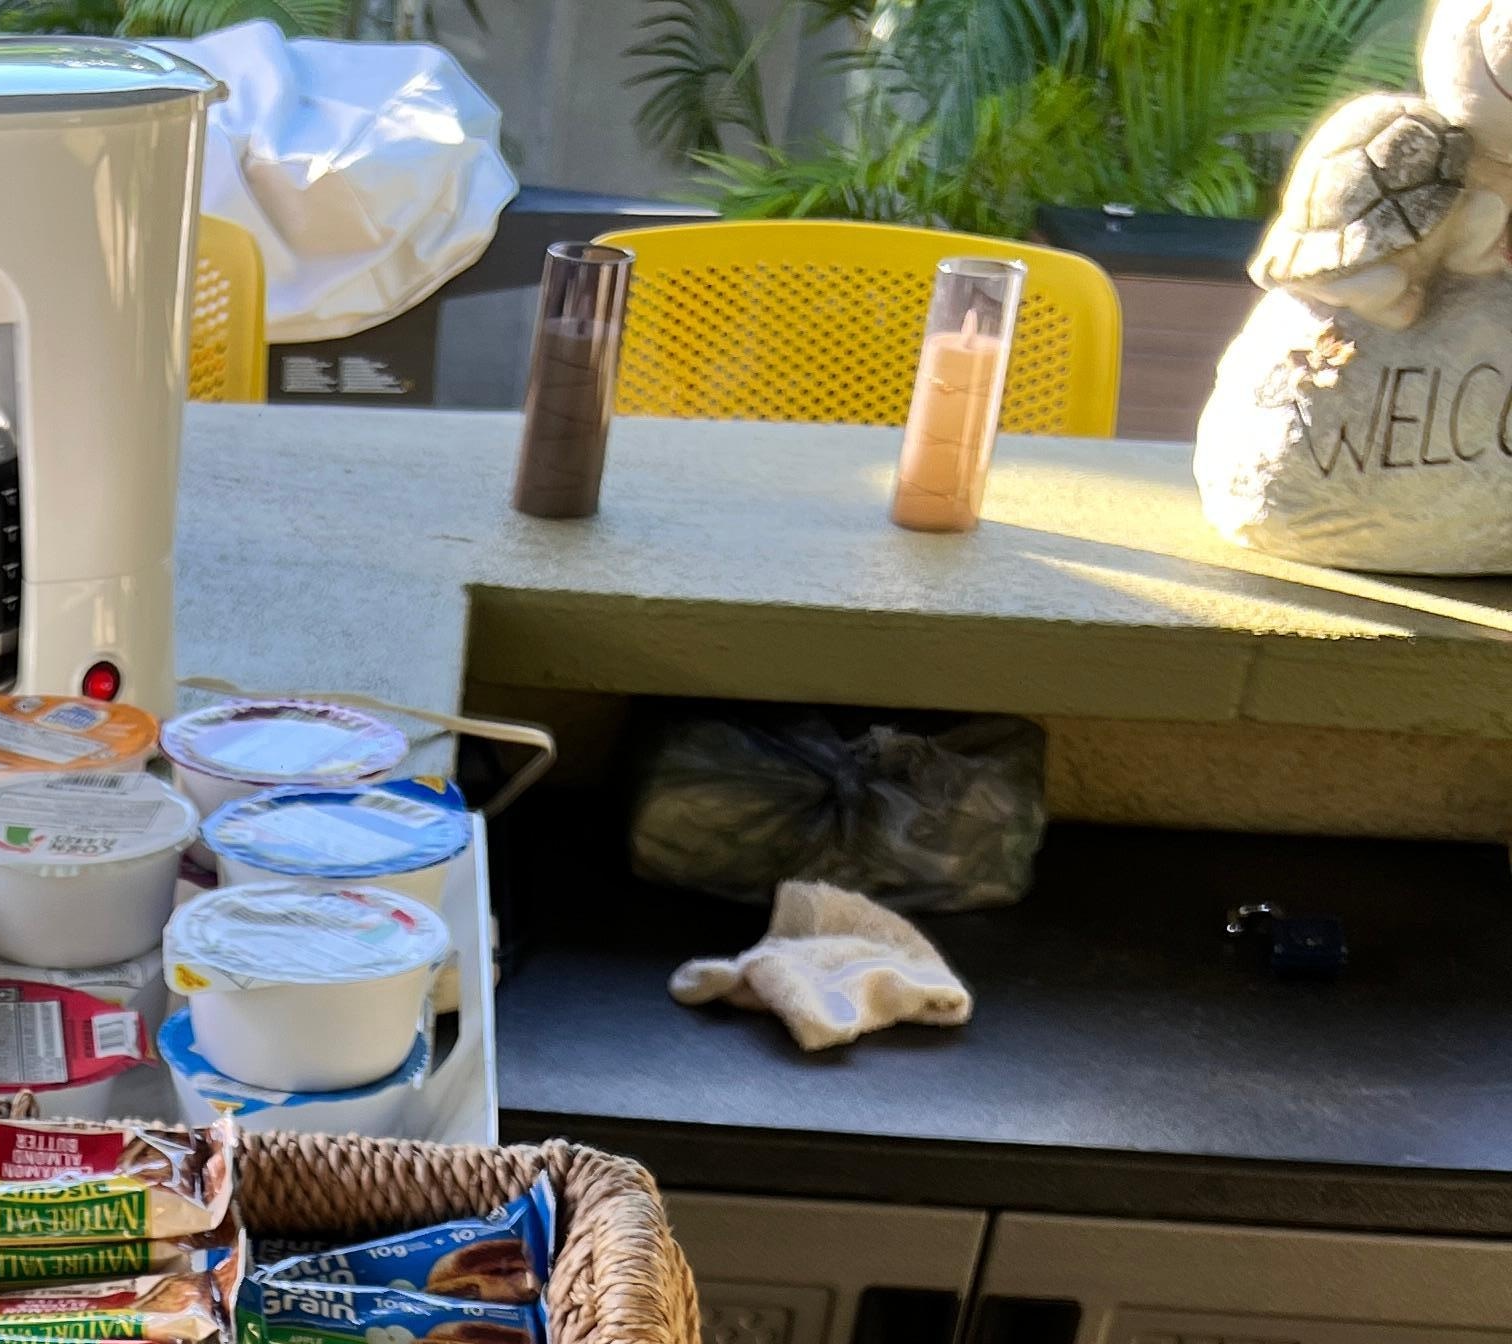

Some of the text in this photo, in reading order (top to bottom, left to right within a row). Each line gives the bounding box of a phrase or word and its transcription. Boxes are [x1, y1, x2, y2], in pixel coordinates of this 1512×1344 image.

[47, 1194, 138, 1233] NATURE
[51, 1243, 144, 1275] NATURE
[262, 1290, 360, 1323] Grain
